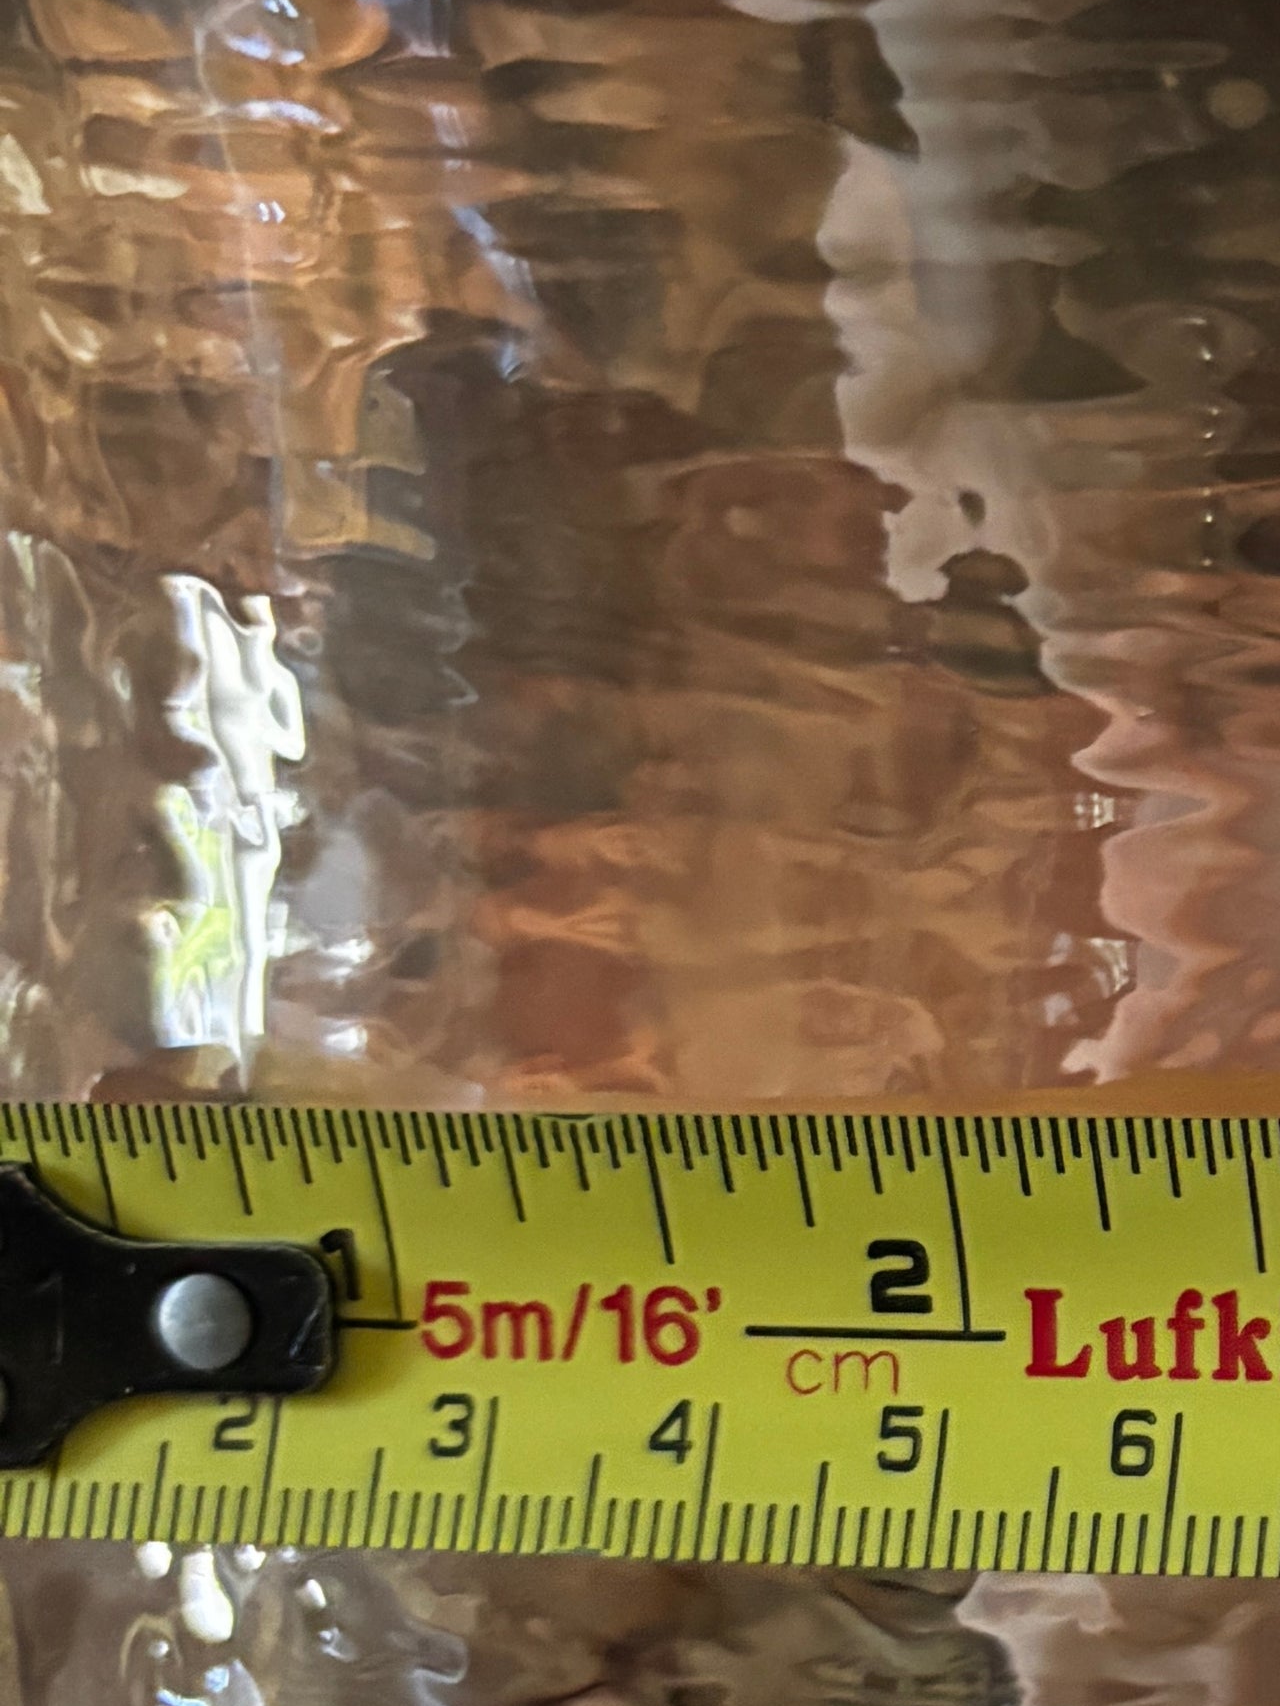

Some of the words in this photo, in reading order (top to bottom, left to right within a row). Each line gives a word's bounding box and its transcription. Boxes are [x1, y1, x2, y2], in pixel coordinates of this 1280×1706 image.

[320, 1228, 361, 1301] 1
[866, 1239, 934, 1313] 2
[785, 1347, 900, 1396] cm
[213, 1395, 258, 1451] 2
[428, 1394, 473, 1460] 3
[648, 1405, 692, 1465] 4
[876, 1407, 922, 1473] 5
[1110, 1409, 1156, 1477] 6
